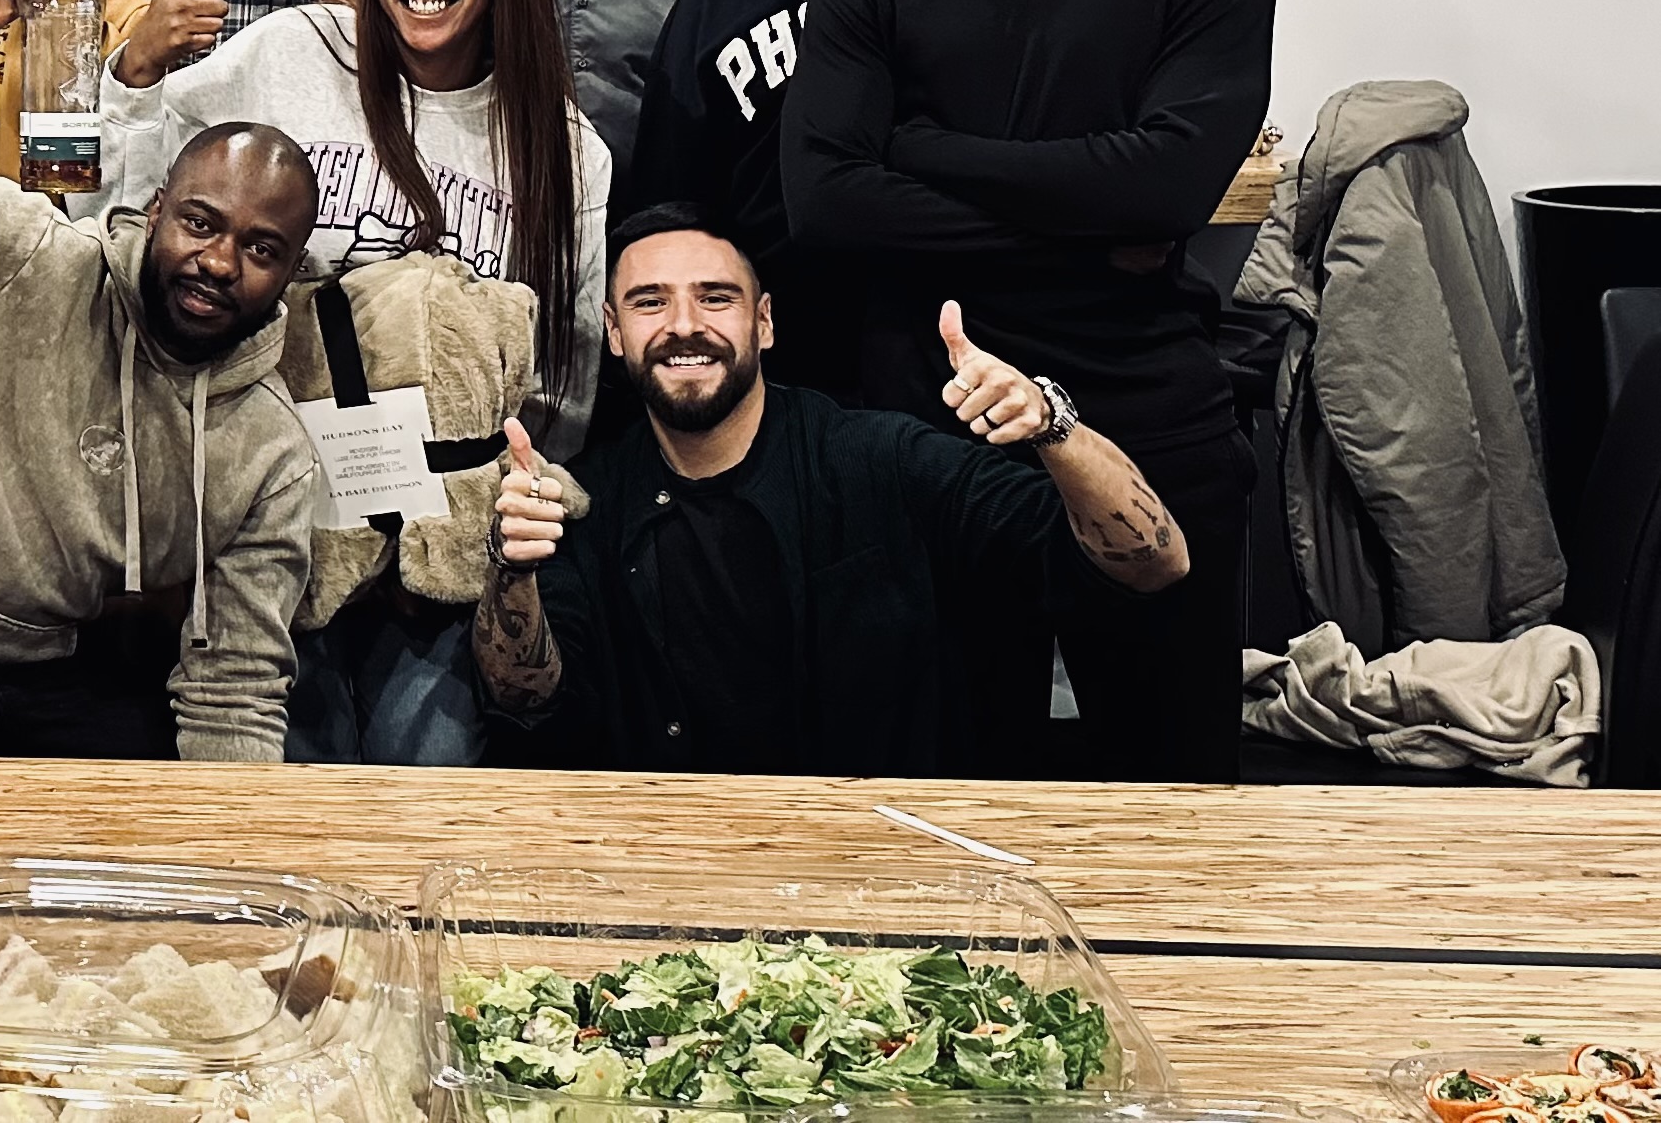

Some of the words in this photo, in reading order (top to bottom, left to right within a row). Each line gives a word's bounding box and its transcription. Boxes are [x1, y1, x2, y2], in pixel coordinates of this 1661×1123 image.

[716, 1, 808, 122] PH
[321, 427, 379, 441] HUDSON'S
[382, 424, 404, 434] BAY
[329, 490, 343, 499] LA
[345, 487, 370, 497] BAIE
